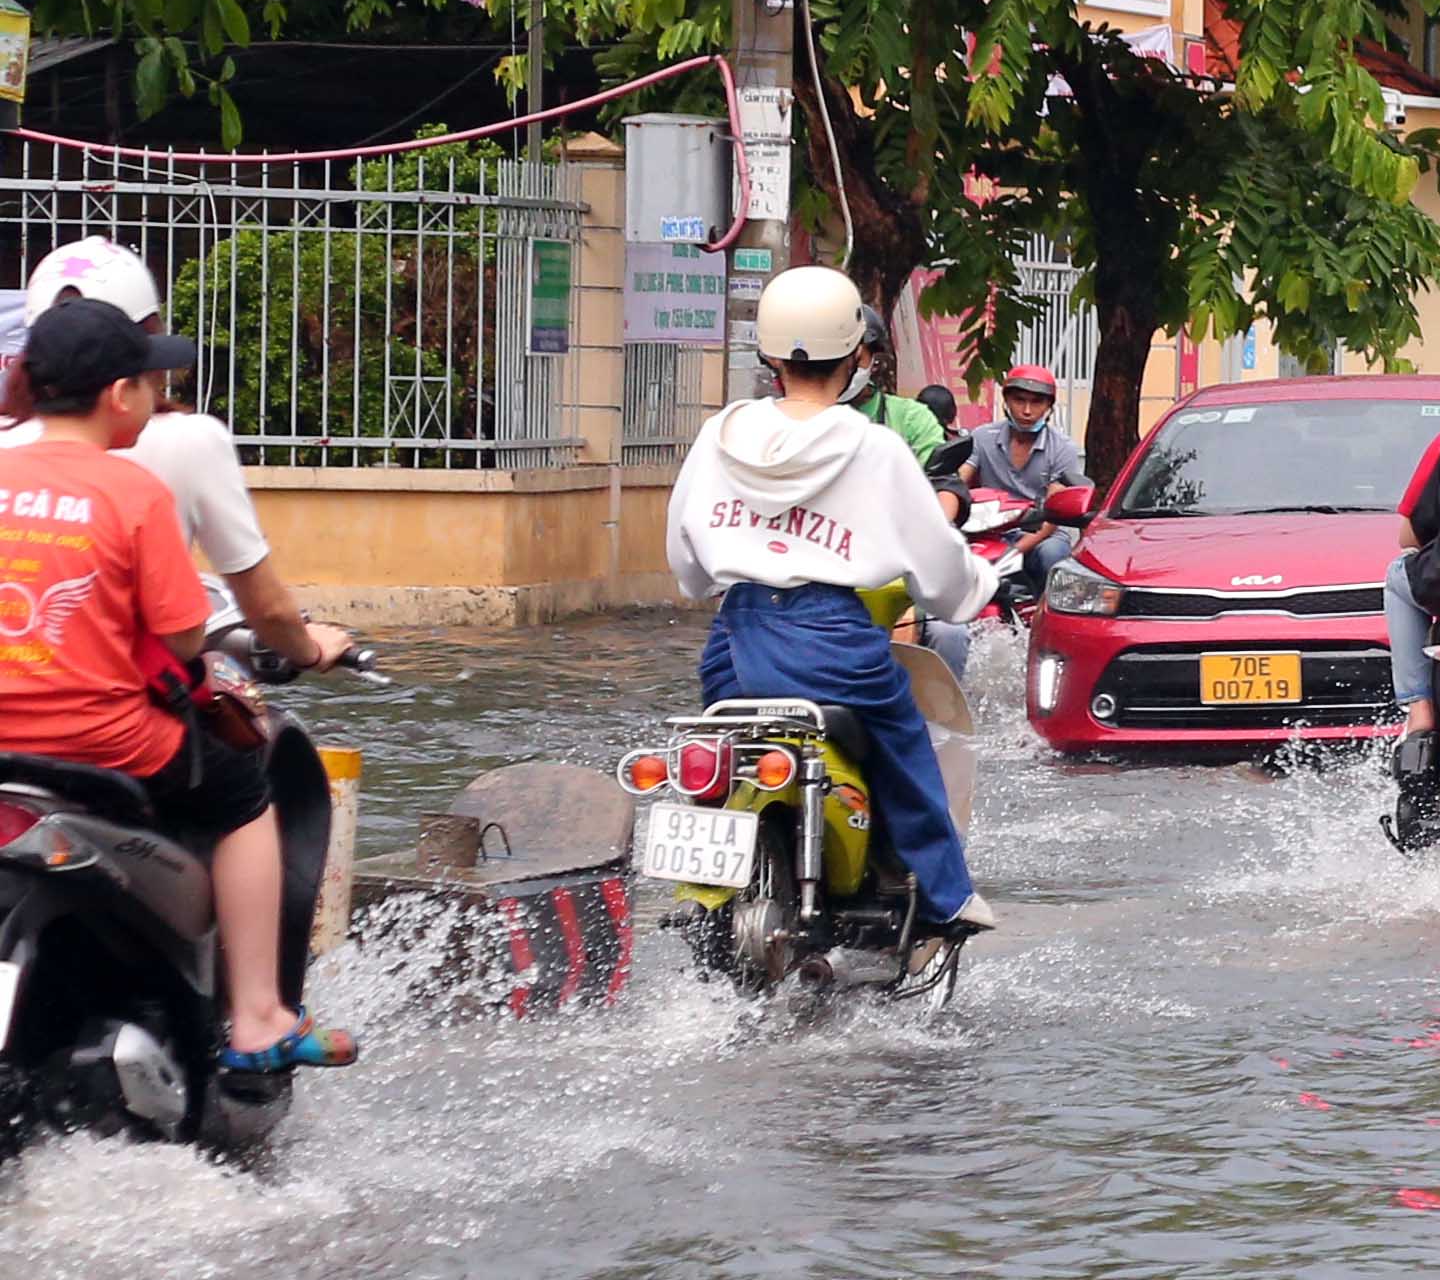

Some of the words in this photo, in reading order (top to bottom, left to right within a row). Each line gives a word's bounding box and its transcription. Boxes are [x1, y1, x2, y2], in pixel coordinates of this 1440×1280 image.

[1230, 657, 1271, 677] 70E
[1212, 679, 1290, 700] 007.19
[667, 811, 738, 848] 93-LA
[651, 843, 746, 881] 005.97
